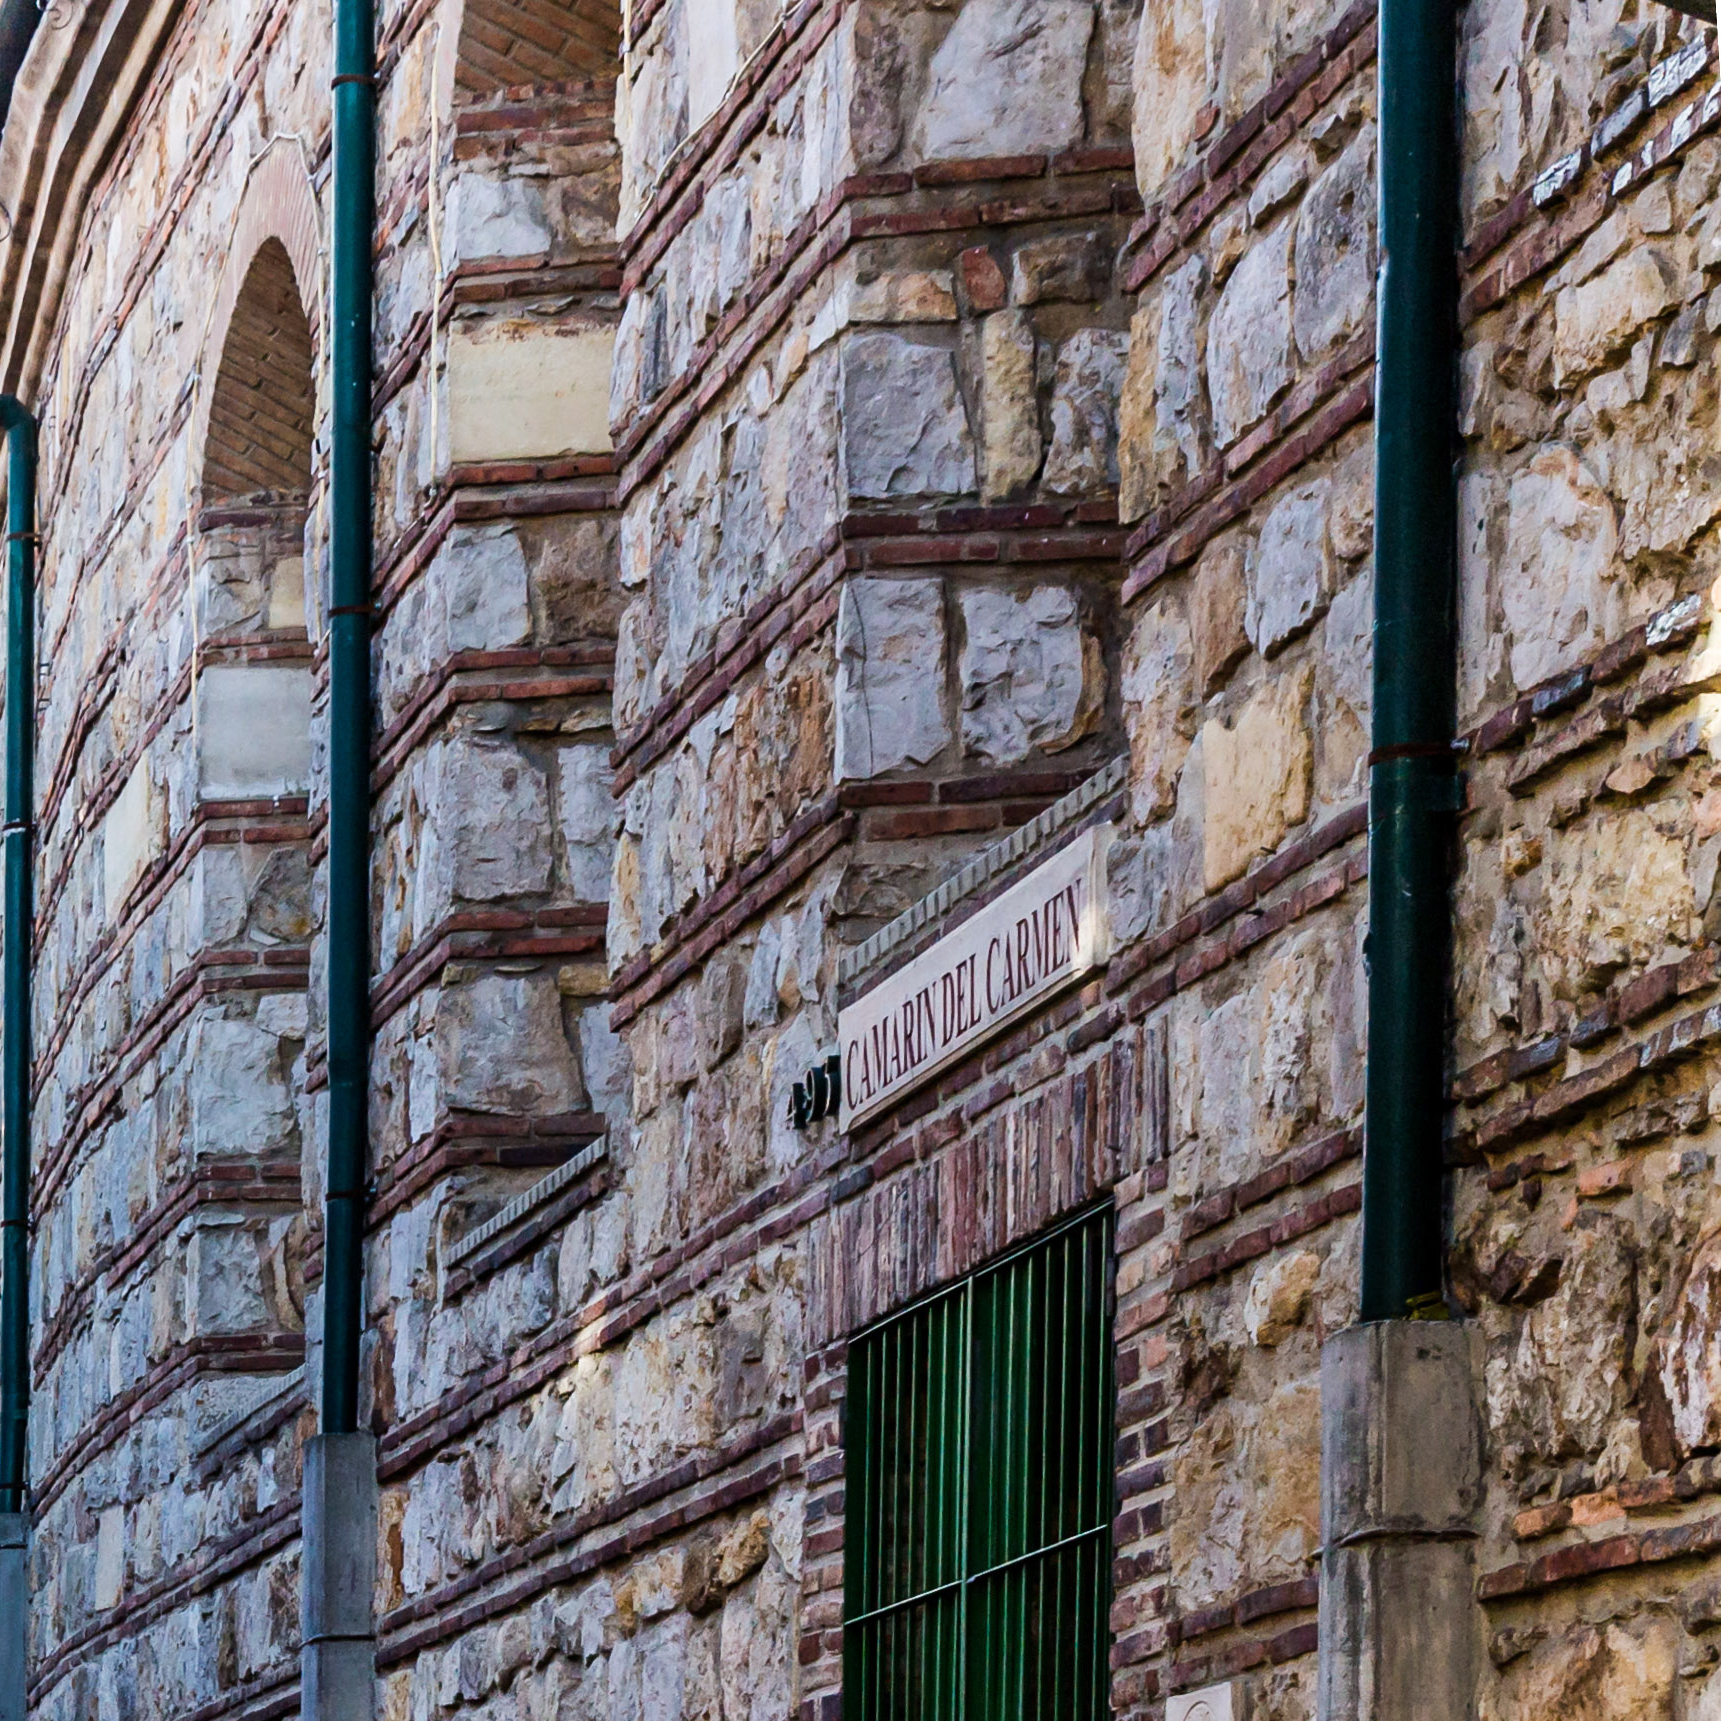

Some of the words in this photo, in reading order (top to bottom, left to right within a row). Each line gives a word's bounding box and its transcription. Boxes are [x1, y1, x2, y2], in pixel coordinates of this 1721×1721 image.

[846, 980, 937, 1111] CAMARIN
[941, 952, 982, 1048] DEL
[985, 878, 1082, 1015] CARMEN
